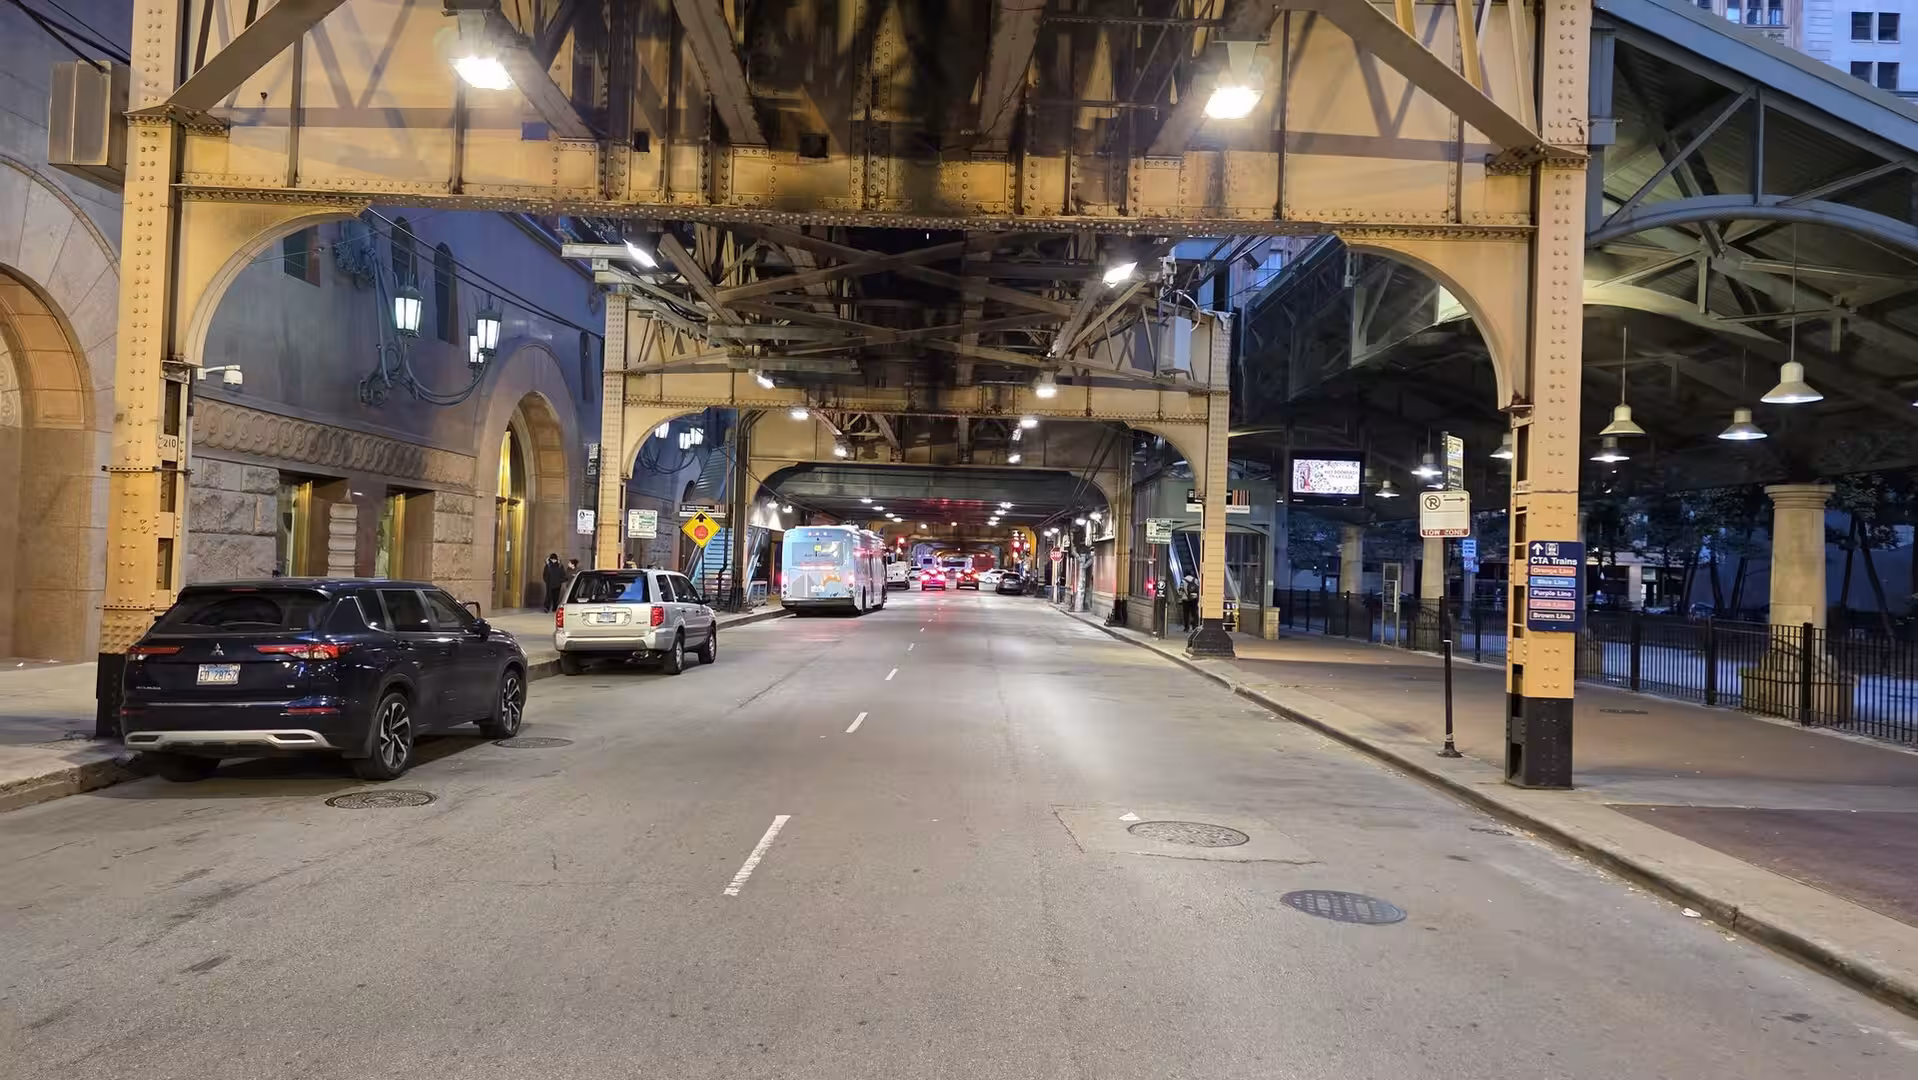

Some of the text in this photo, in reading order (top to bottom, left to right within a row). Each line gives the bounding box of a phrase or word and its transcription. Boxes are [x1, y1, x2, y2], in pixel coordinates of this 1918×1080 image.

[163, 438, 177, 448] 210
[1530, 556, 1578, 566] CTA Trains
[1533, 567, 1557, 575] Orange
[1533, 590, 1556, 598] Purple
